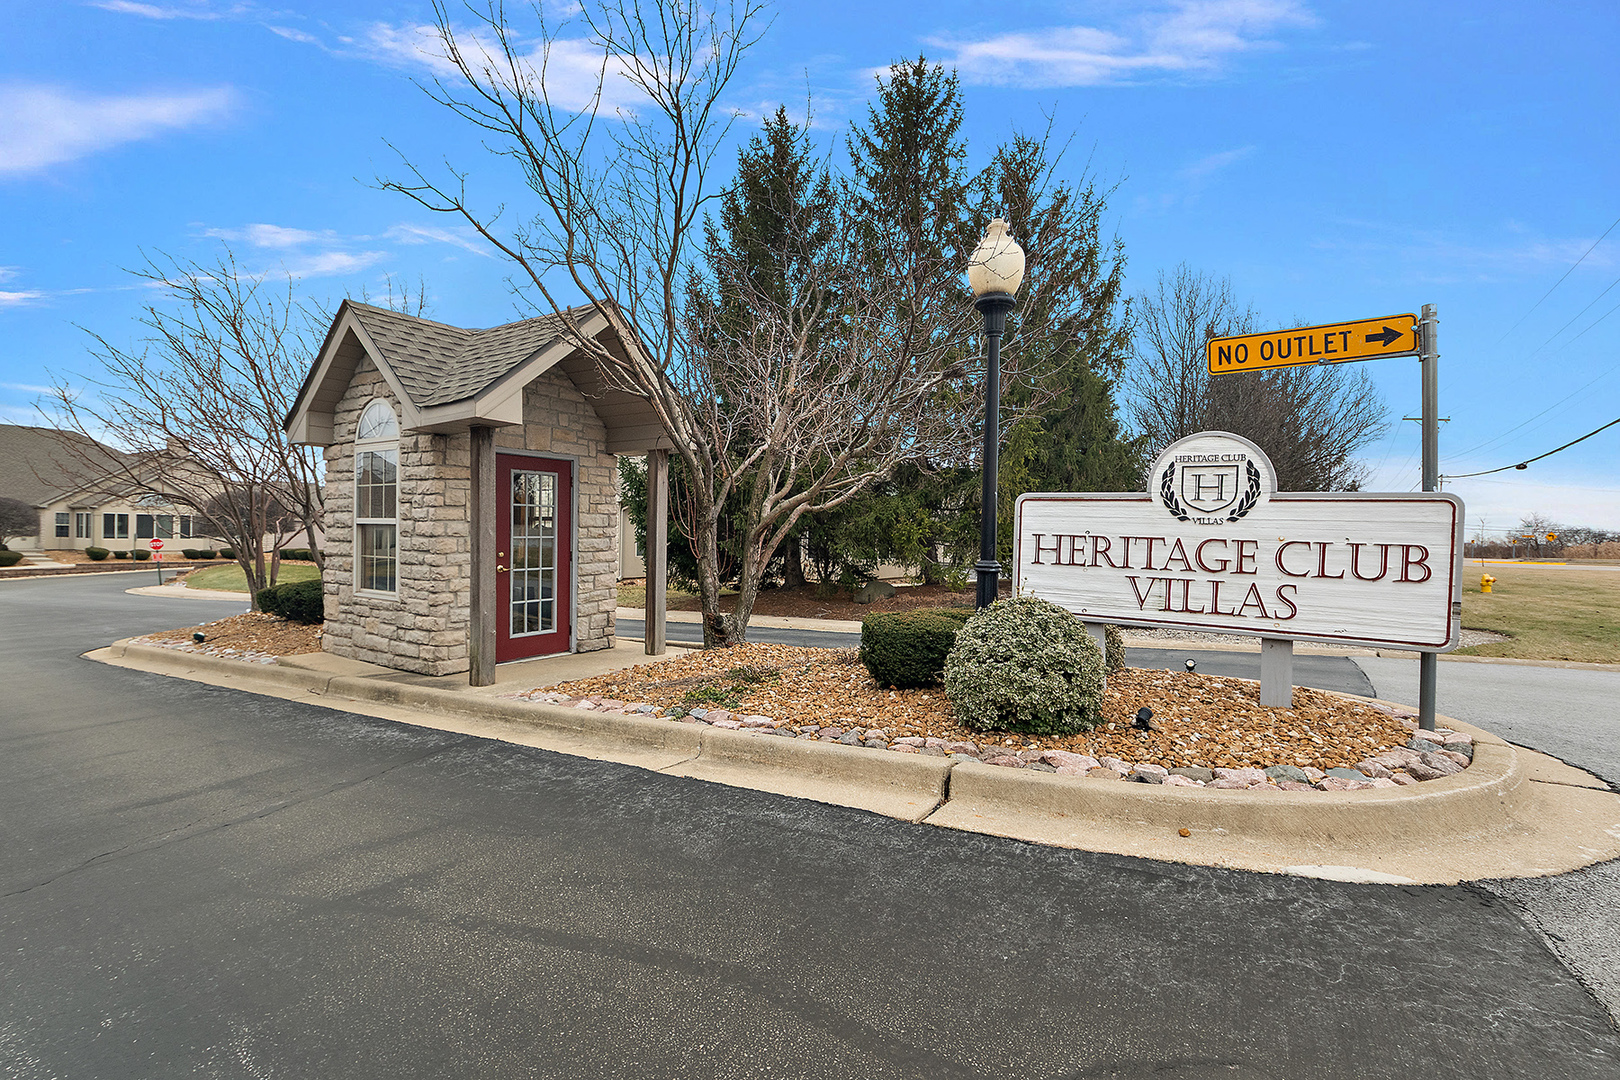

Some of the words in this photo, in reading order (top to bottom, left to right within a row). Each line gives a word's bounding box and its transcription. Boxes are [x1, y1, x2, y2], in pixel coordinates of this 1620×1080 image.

[1217, 343, 1249, 366] NO
[1259, 330, 1352, 361] OUTLET
[1175, 454, 1219, 463] HERITAGE
[1221, 454, 1247, 462] CLUB
[1190, 473, 1229, 502] H
[1191, 517, 1225, 525] VILLAS
[1031, 533, 1260, 575] HERITAGE
[1274, 540, 1433, 583] CLUB
[1125, 575, 1299, 620] VILLAS
